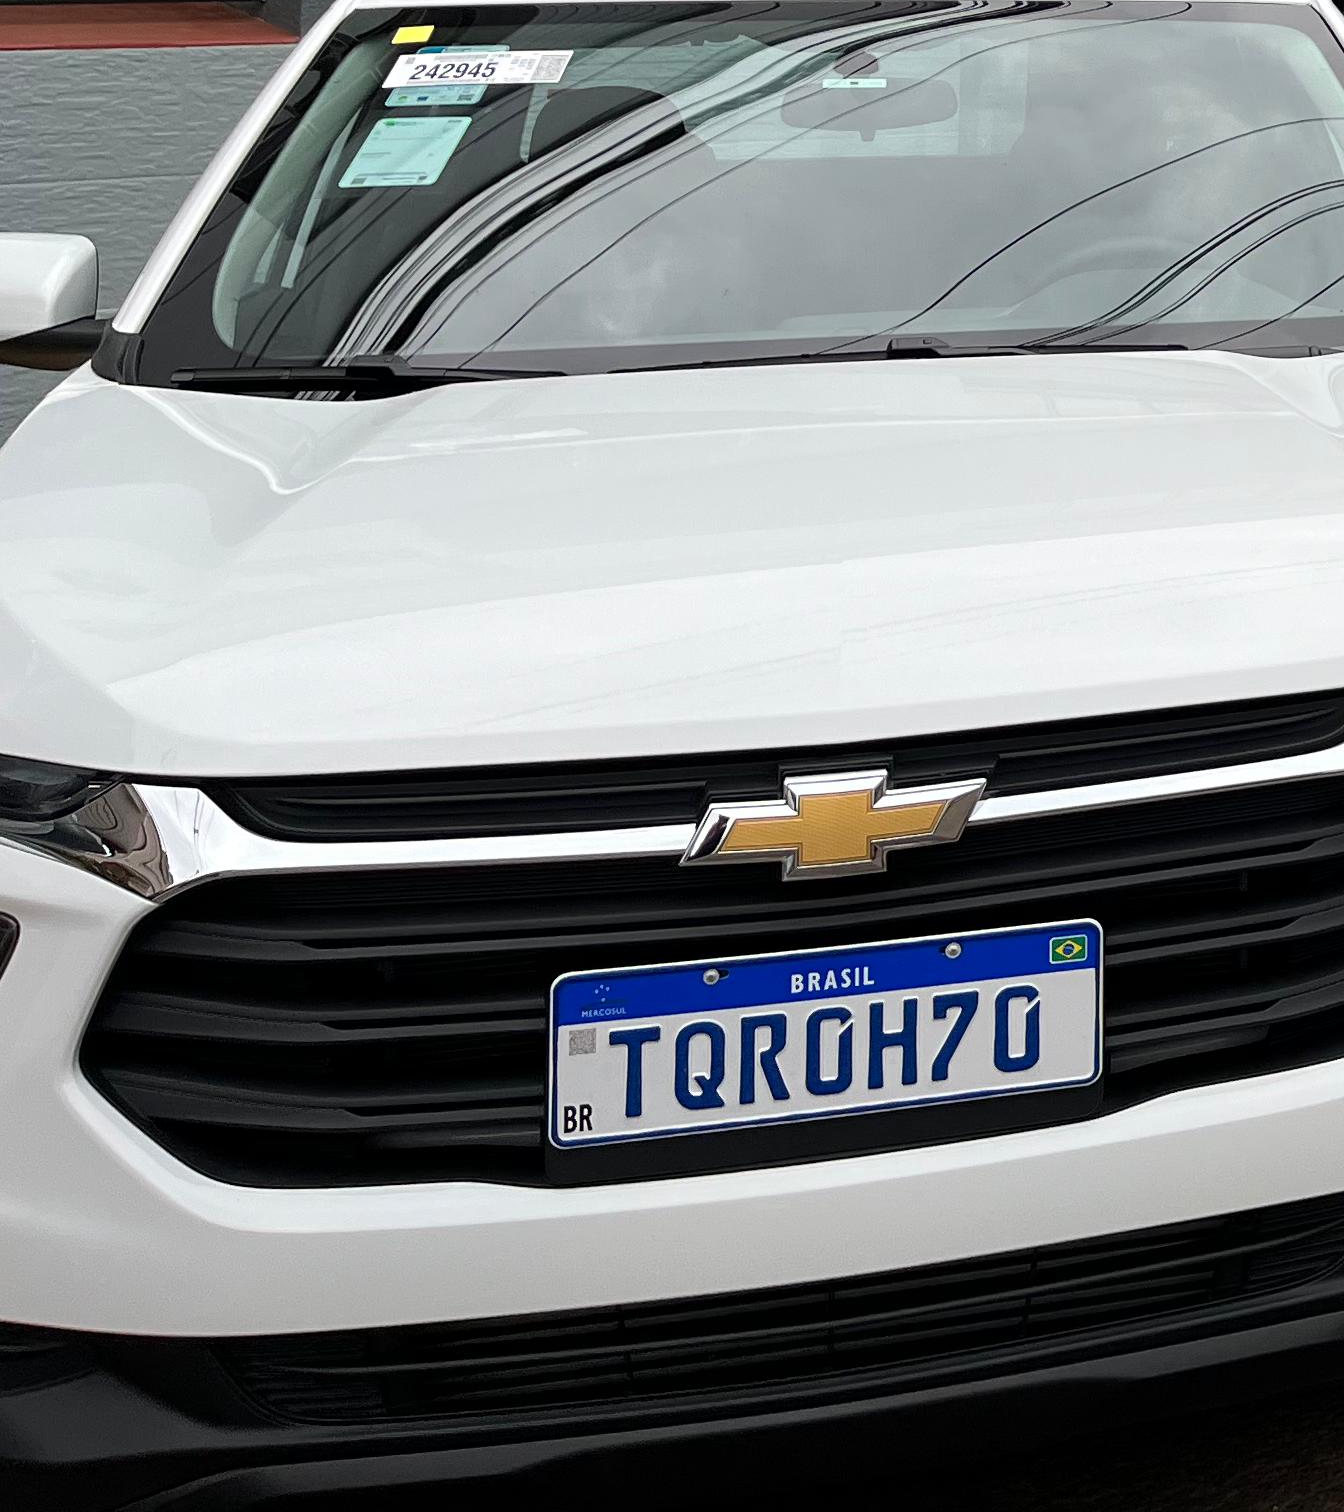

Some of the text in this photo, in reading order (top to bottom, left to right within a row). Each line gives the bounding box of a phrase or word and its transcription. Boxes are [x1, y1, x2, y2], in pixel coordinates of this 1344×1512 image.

[409, 62, 499, 81] 242945
[790, 965, 876, 995] BRASIL
[580, 1006, 627, 1019] MERCOSUL
[562, 1103, 594, 1135] BR
